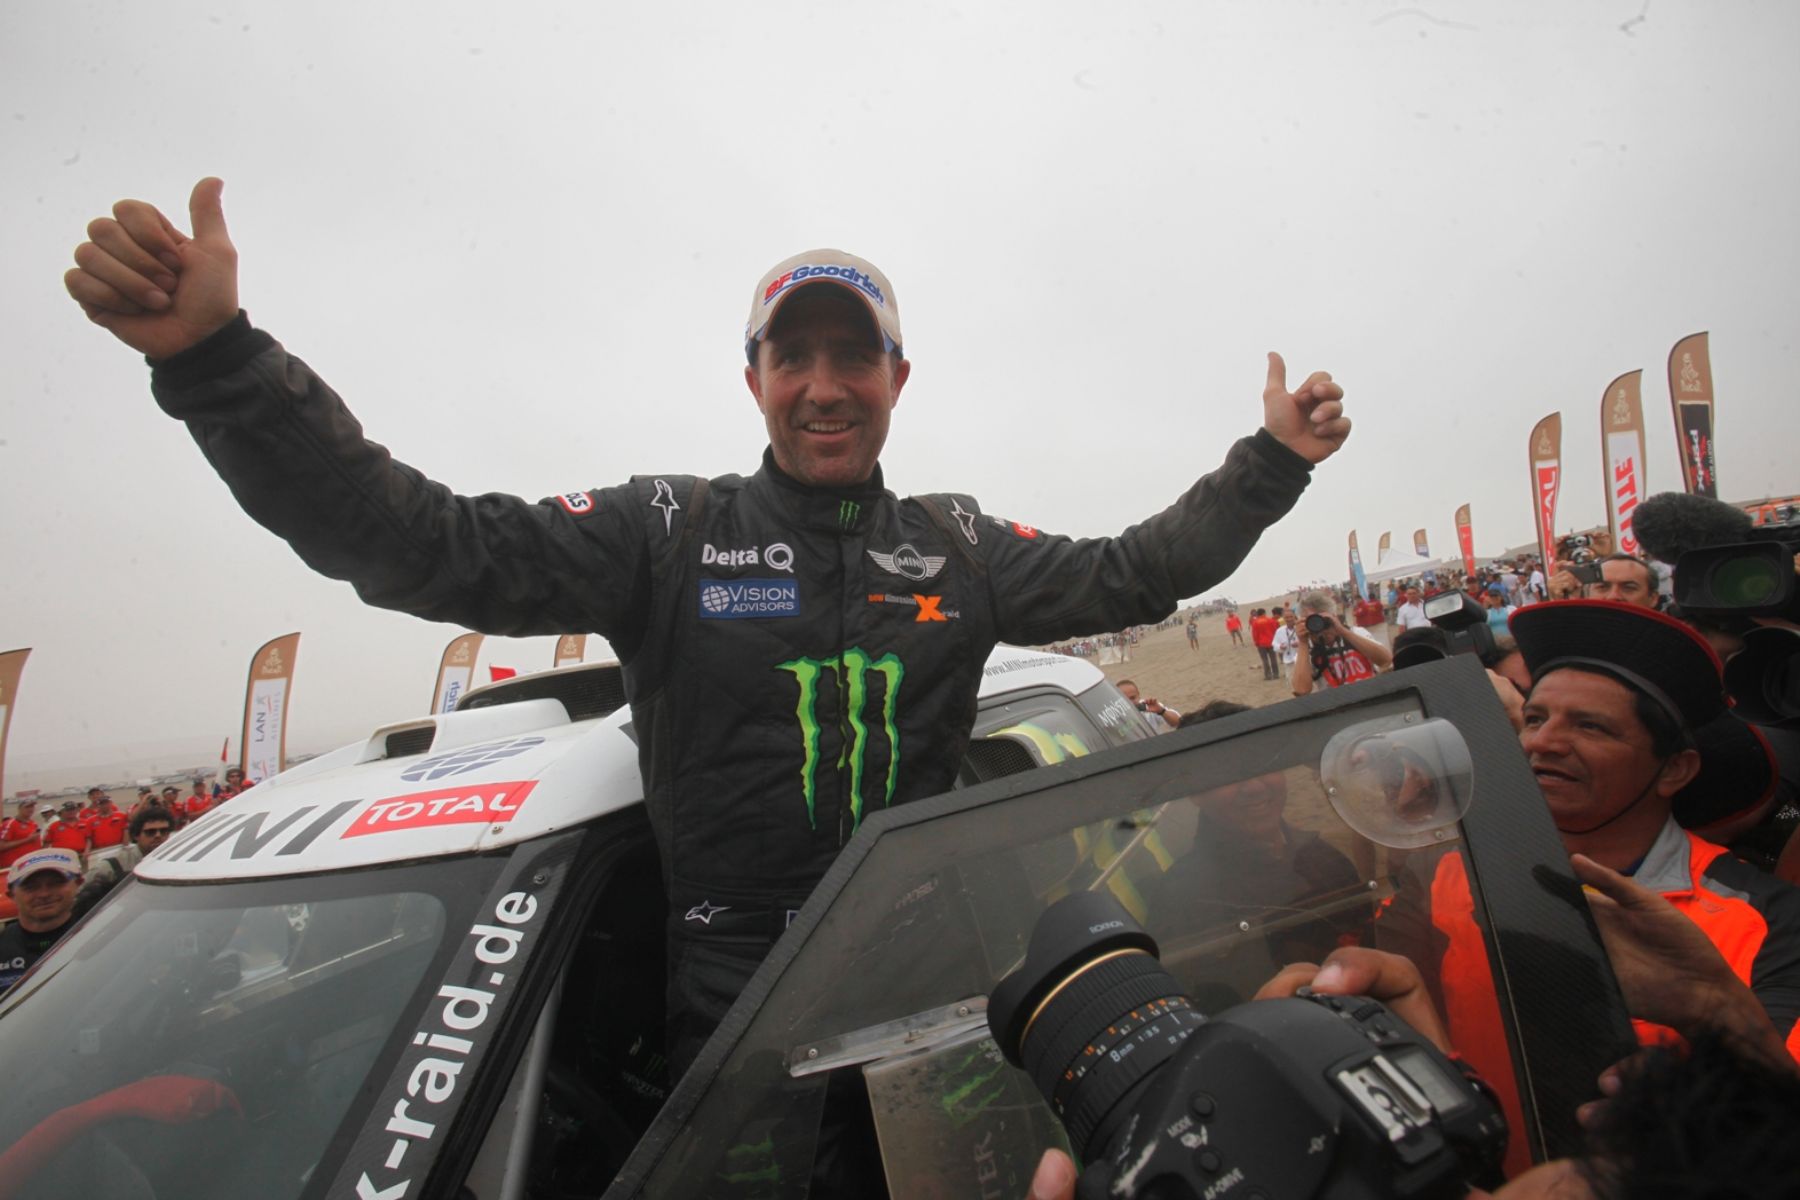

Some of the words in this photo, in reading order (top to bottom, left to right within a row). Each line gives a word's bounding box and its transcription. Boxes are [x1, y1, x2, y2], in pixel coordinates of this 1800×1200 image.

[764, 265, 885, 304] BFGoodrich
[701, 543, 759, 570] Delta
[764, 542, 794, 573] Q
[728, 585, 795, 602] VISION
[731, 601, 795, 613] ADVISORS
[255, 711, 266, 743] LAN
[367, 793, 518, 825] TOTAL
